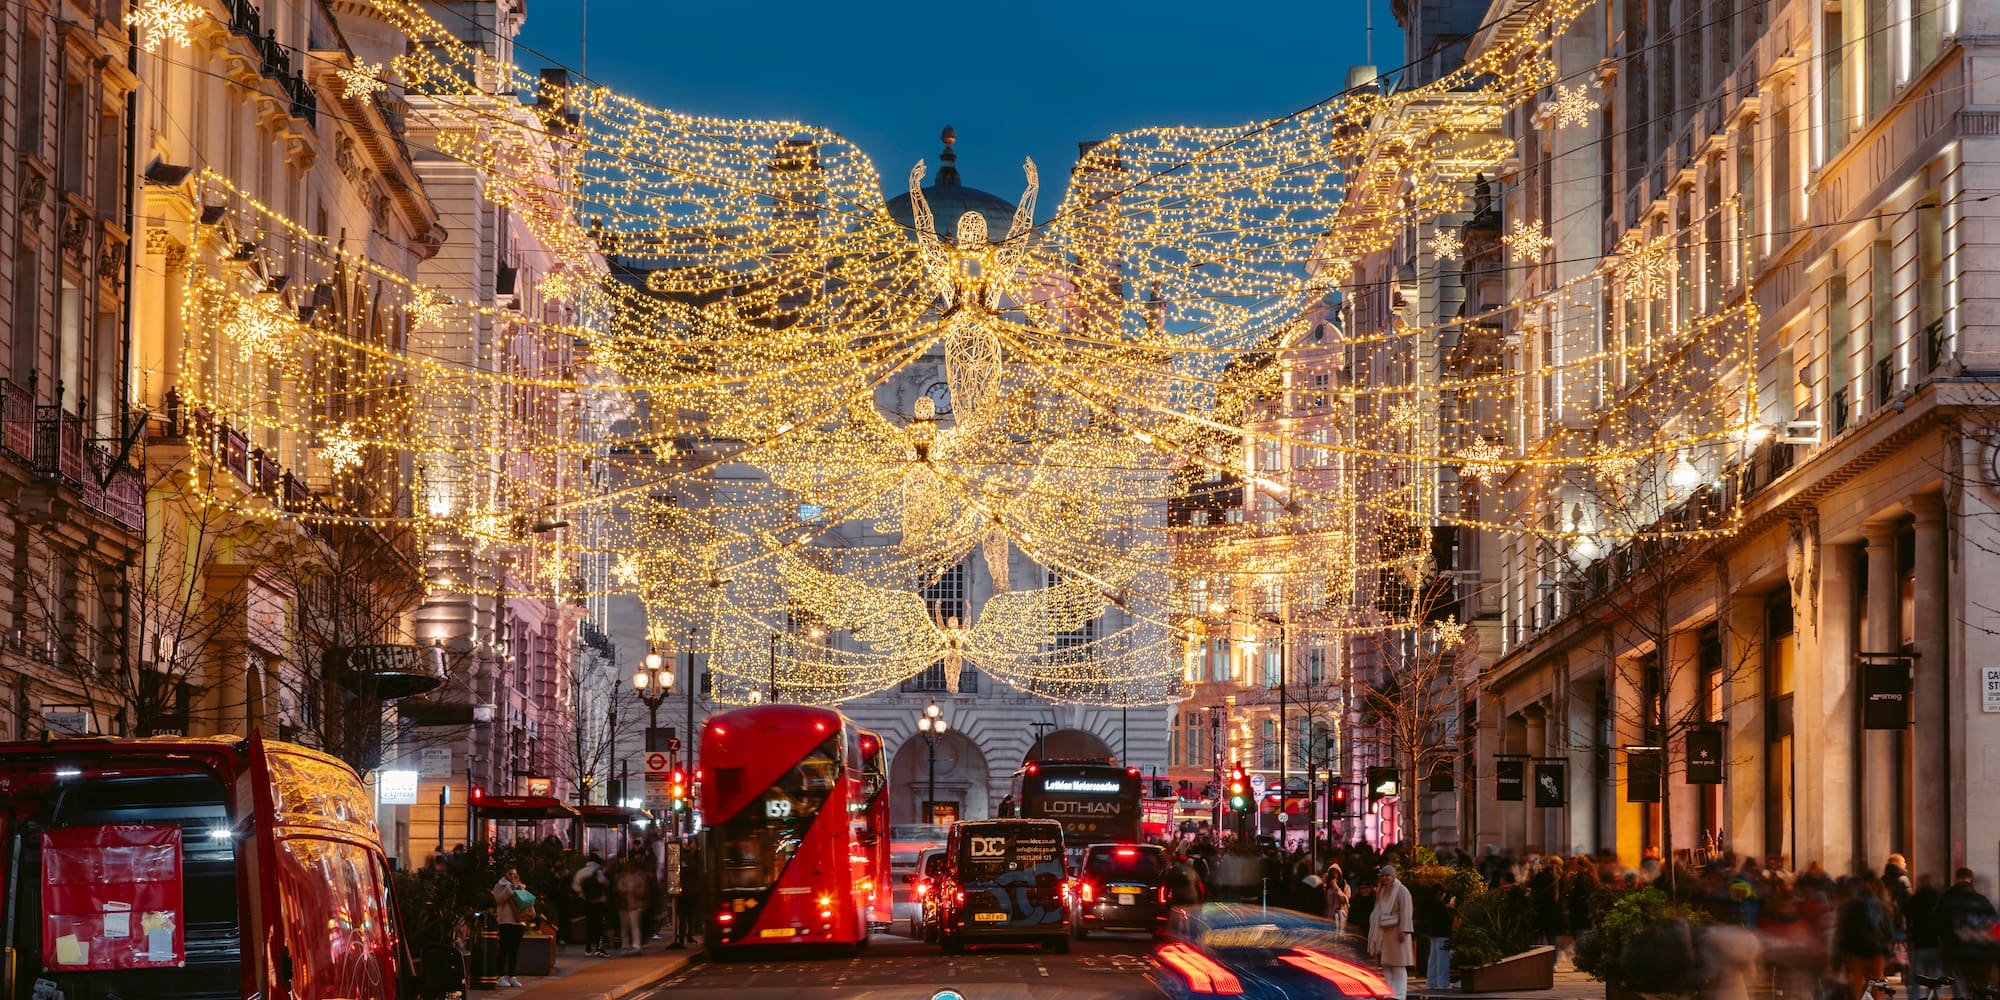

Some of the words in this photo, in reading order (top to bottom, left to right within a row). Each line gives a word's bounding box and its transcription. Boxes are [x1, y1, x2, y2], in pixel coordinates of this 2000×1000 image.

[347, 646, 424, 671] CINEMA
[1988, 682, 2000, 690] ST
[152, 729, 182, 737] COSTA
[670, 740, 679, 750] Z
[1045, 780, 1072, 790] Lothian
[766, 800, 791, 817] 159
[1044, 801, 1120, 814] LOTHIAN
